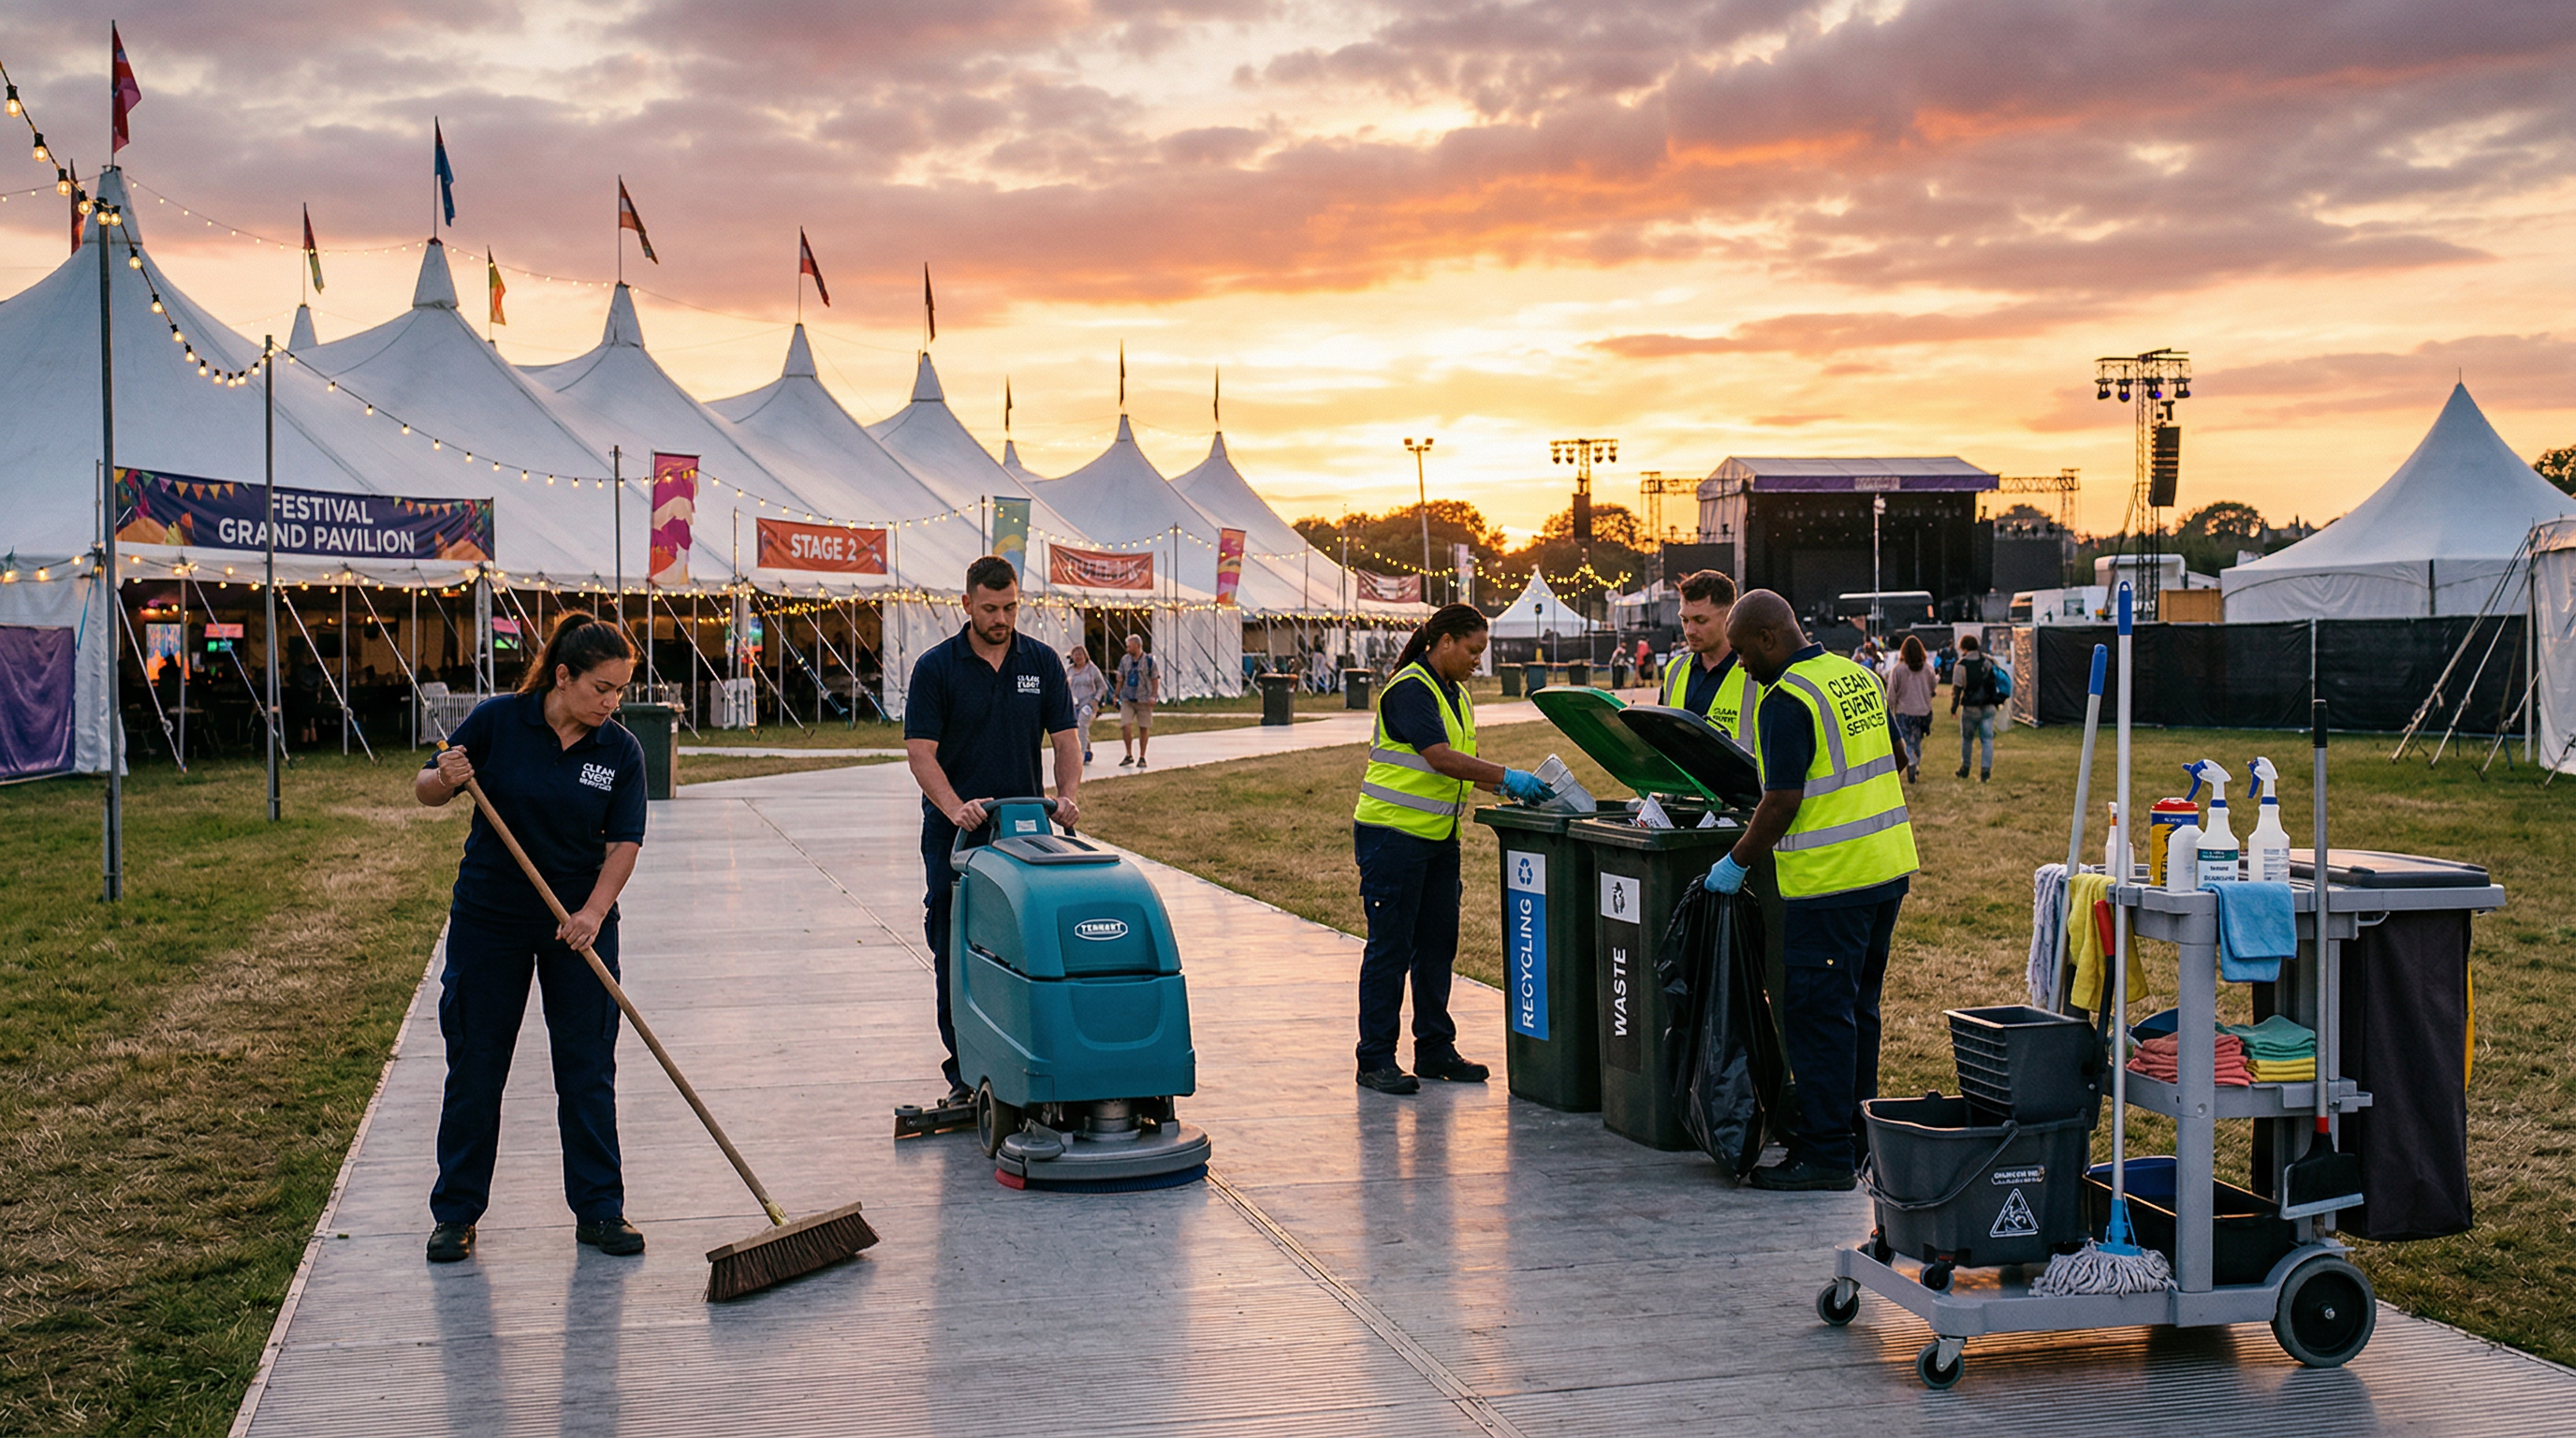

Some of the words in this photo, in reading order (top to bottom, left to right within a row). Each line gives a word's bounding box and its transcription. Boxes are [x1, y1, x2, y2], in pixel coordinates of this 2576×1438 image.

[271, 492, 373, 525] FESTIVAL
[218, 517, 307, 549] GRAND
[314, 526, 415, 554] PAVILION
[791, 533, 843, 561] STAGE
[846, 537, 857, 562] 2
[1839, 691, 1880, 721] EVENT
[1519, 898, 1534, 1029] RECYCLING
[1613, 946, 1628, 1037] WASTE
